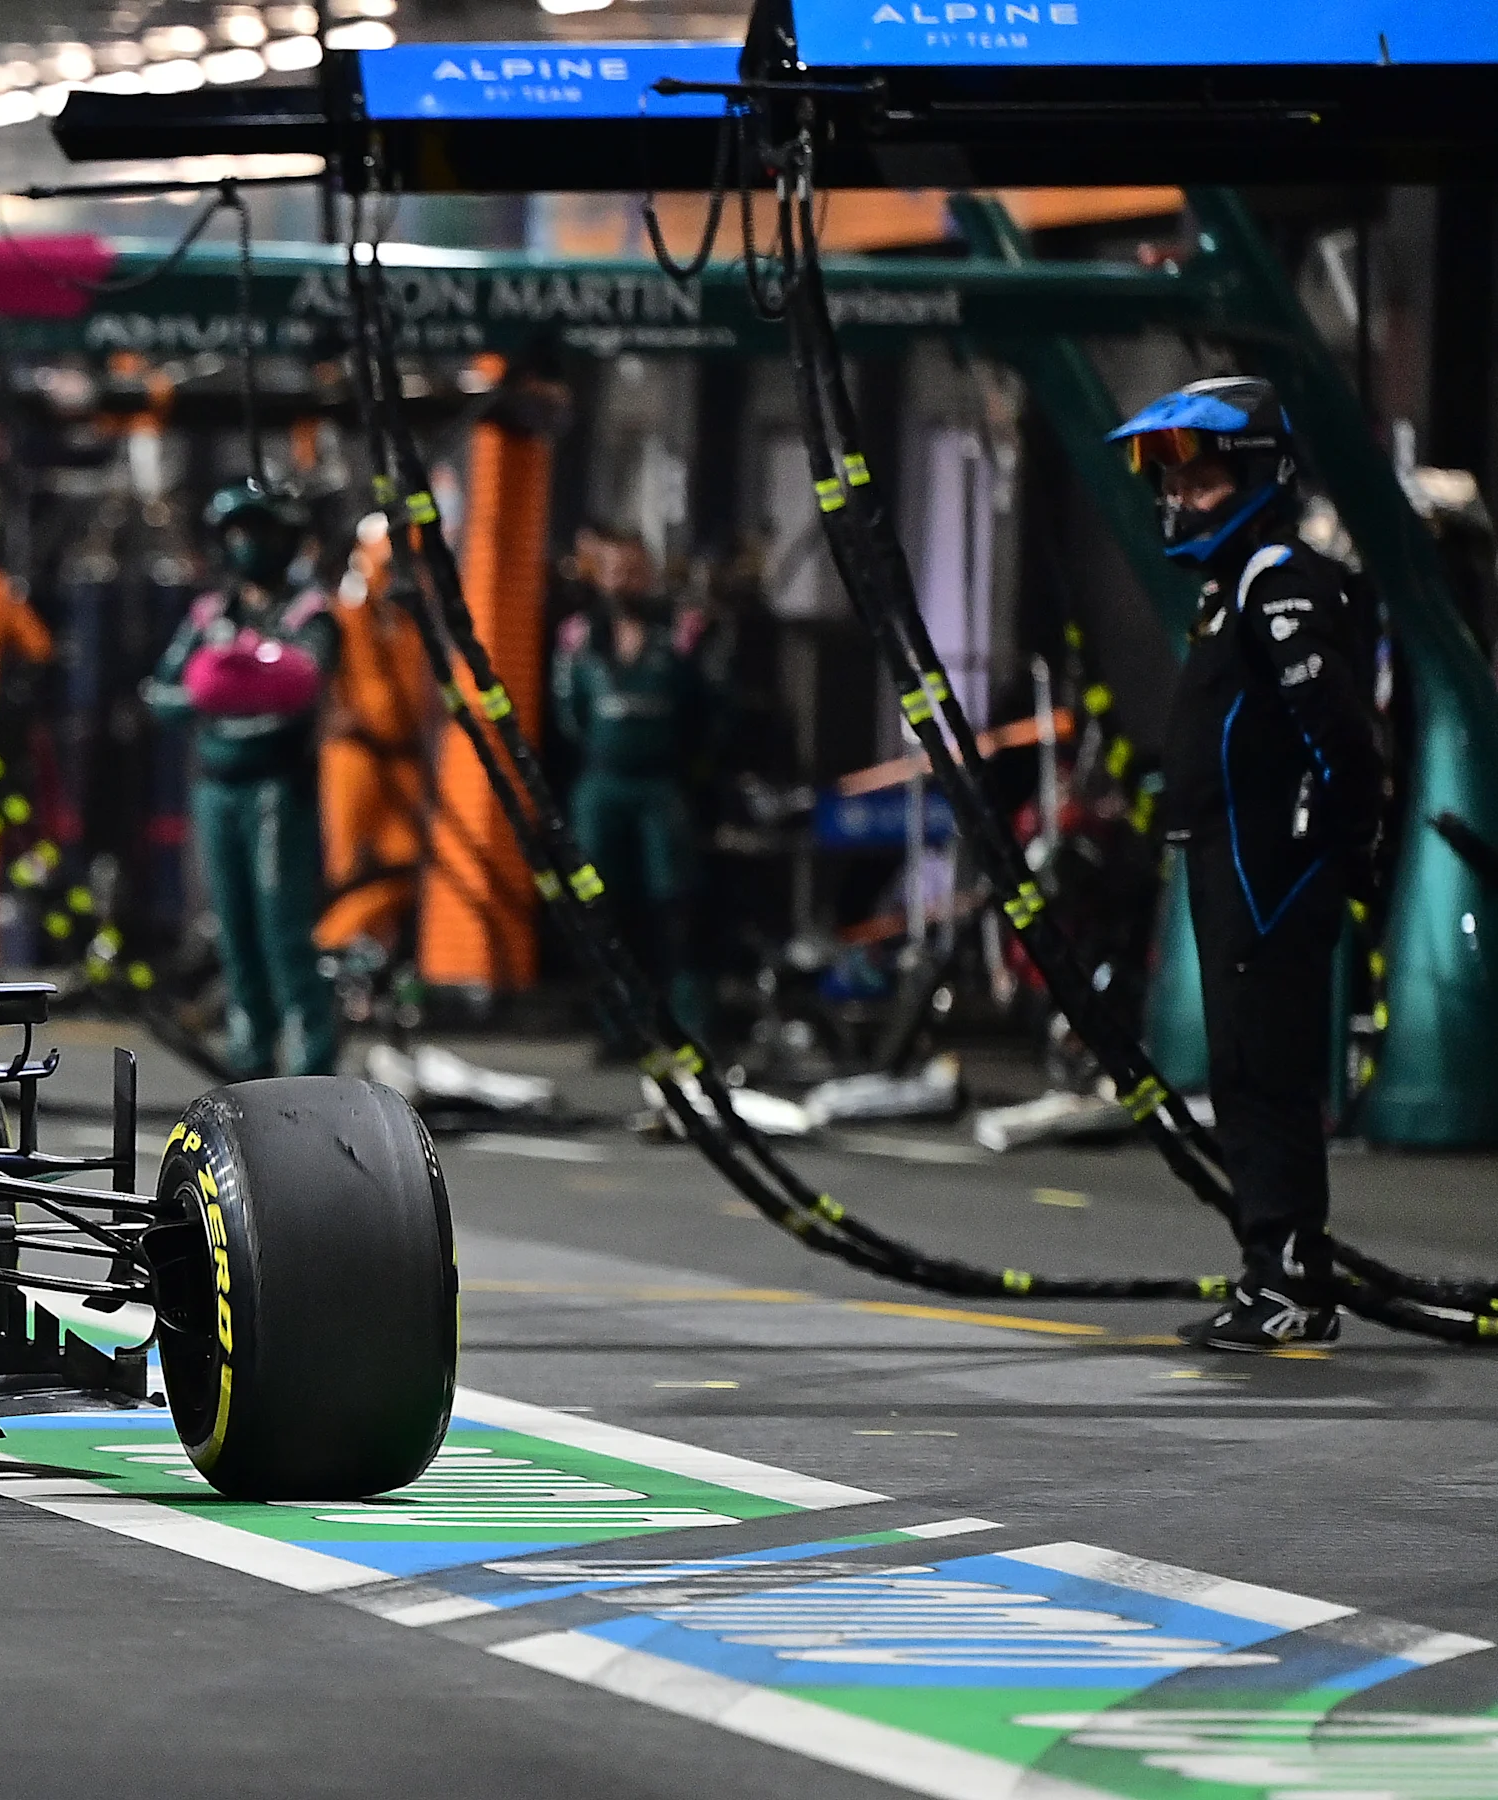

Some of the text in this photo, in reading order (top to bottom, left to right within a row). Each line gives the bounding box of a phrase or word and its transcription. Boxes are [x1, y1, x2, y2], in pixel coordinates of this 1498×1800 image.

[871, 3, 1079, 25] ALPINE
[966, 32, 1029, 49] TEAM
[431, 58, 629, 82] ALPINE
[490, 270, 701, 322] MARTIN
[198, 1163, 233, 1355] ZERO
